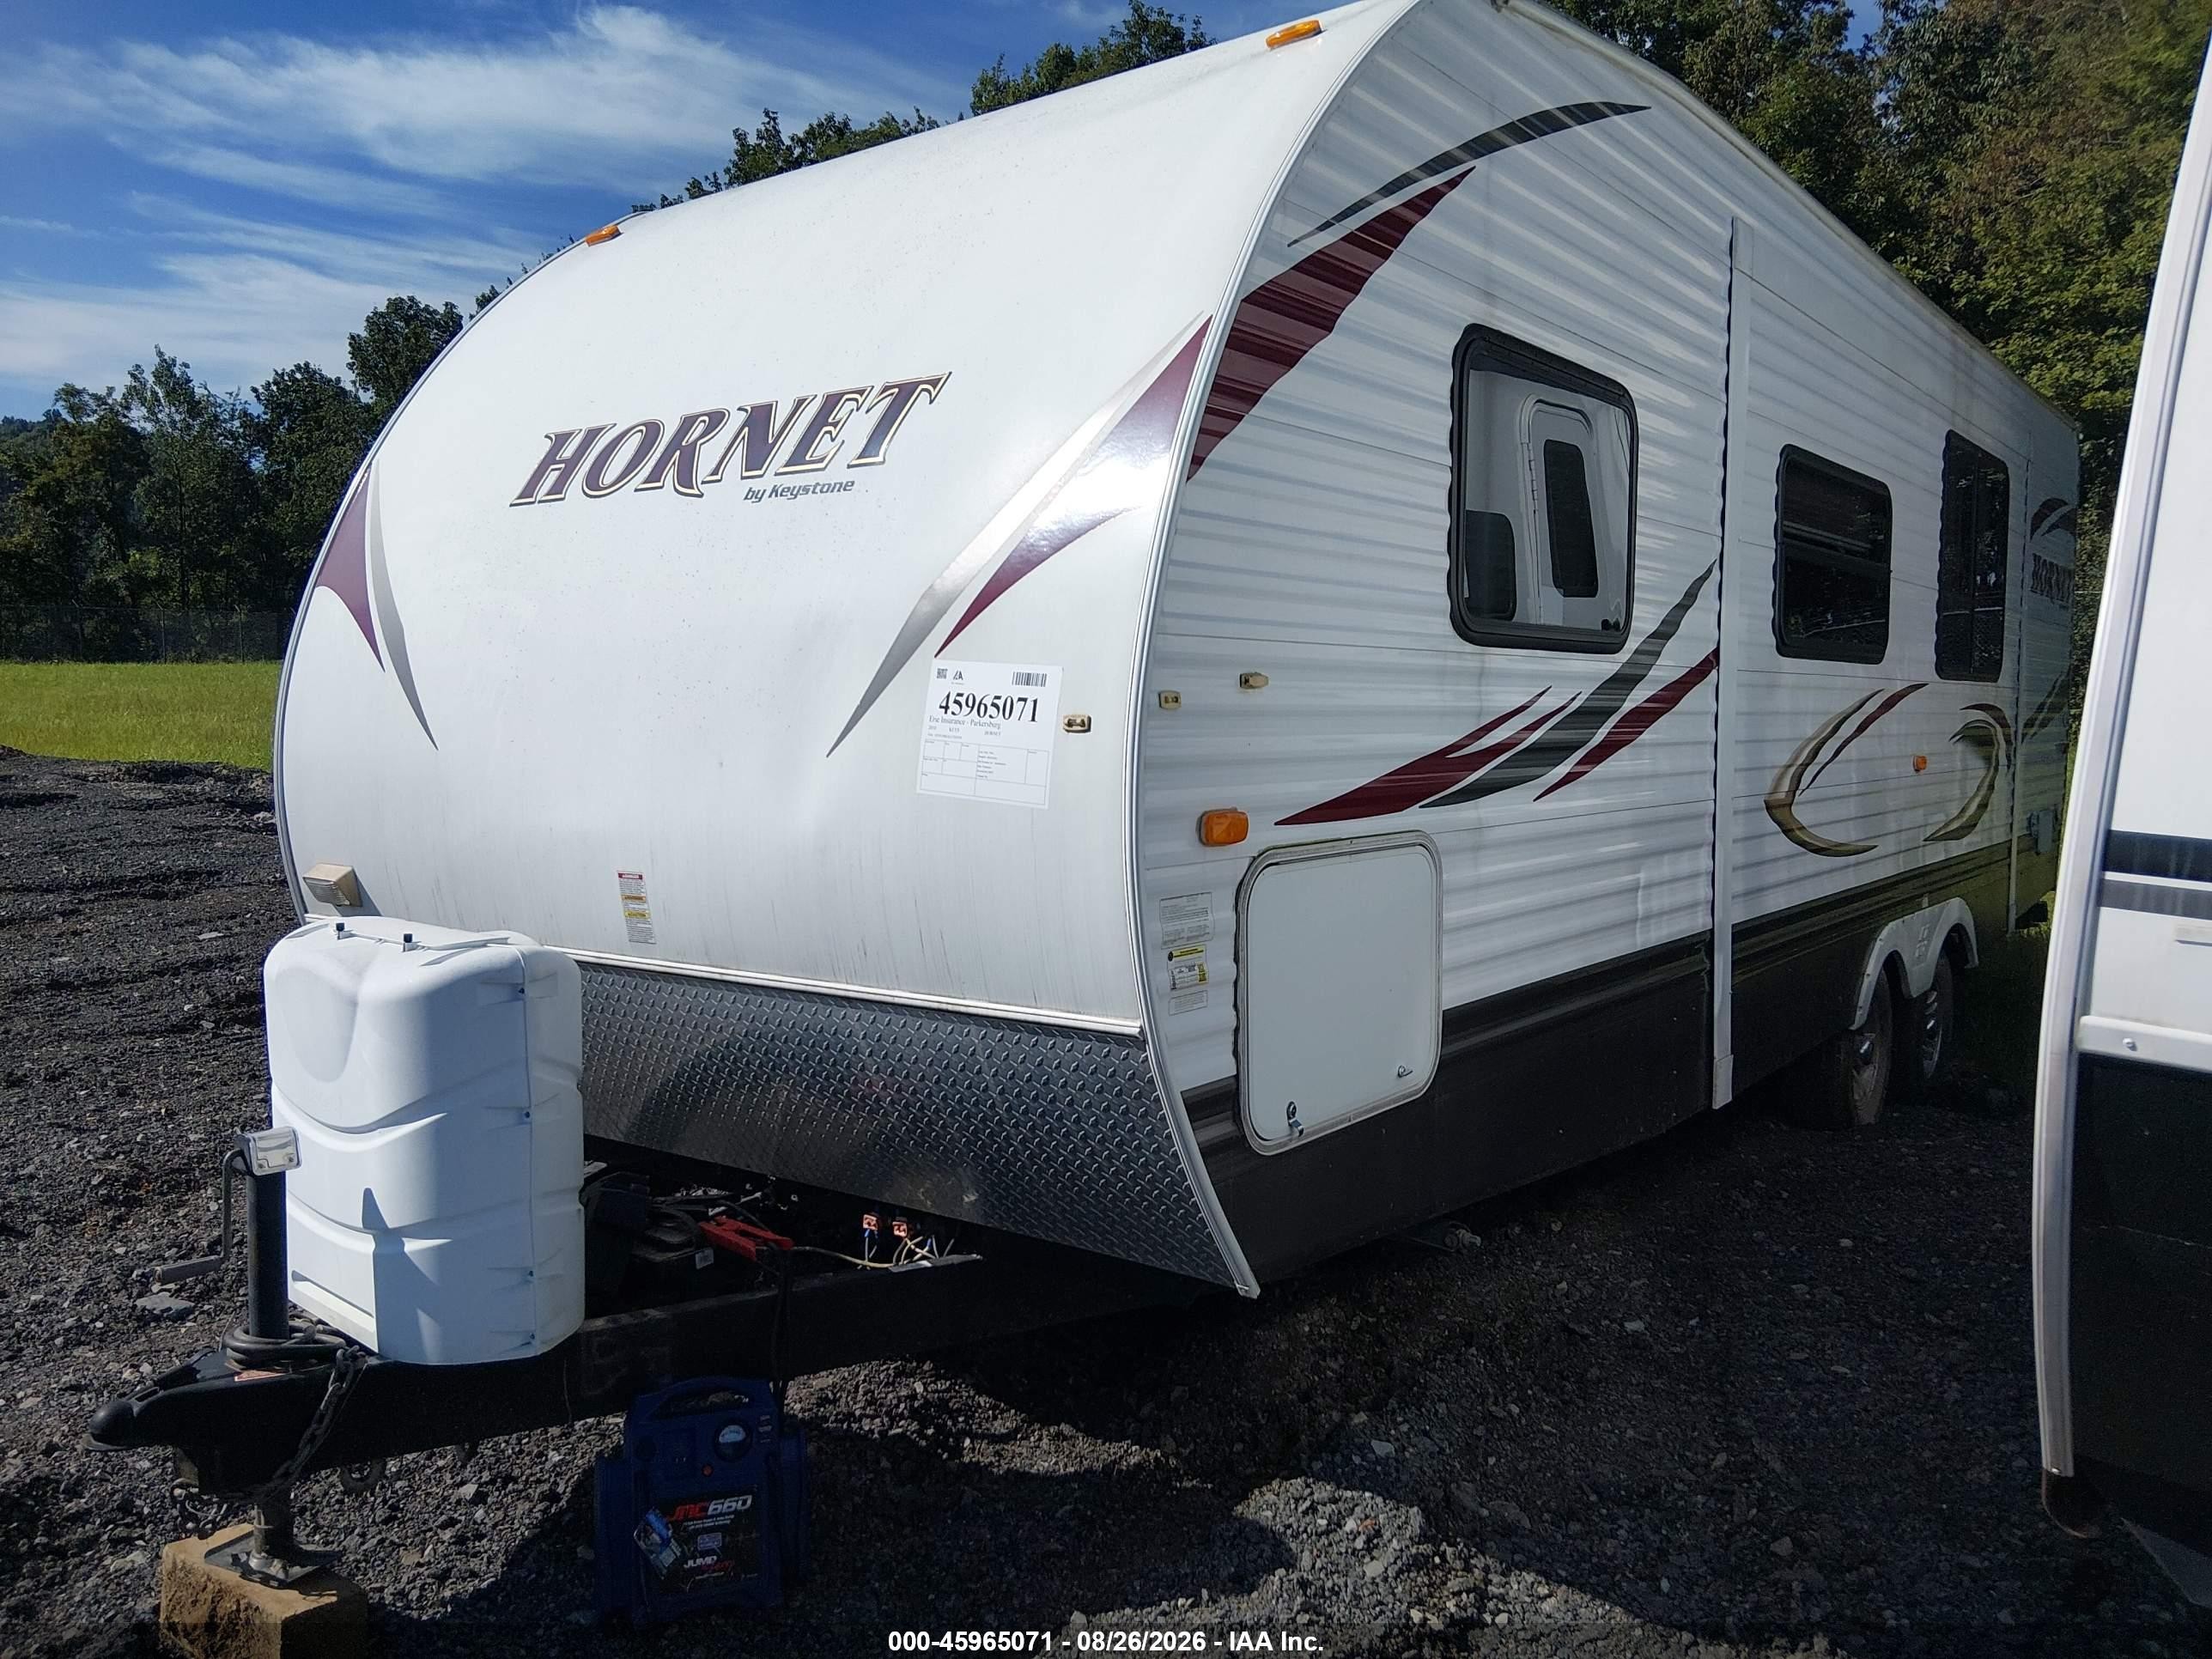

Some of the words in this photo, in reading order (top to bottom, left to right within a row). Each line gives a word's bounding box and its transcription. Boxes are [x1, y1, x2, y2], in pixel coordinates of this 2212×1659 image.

[509, 371, 952, 507] HORNET
[744, 485, 767, 504] by
[769, 478, 856, 501] Keystone
[939, 690, 1039, 723] 45965071
